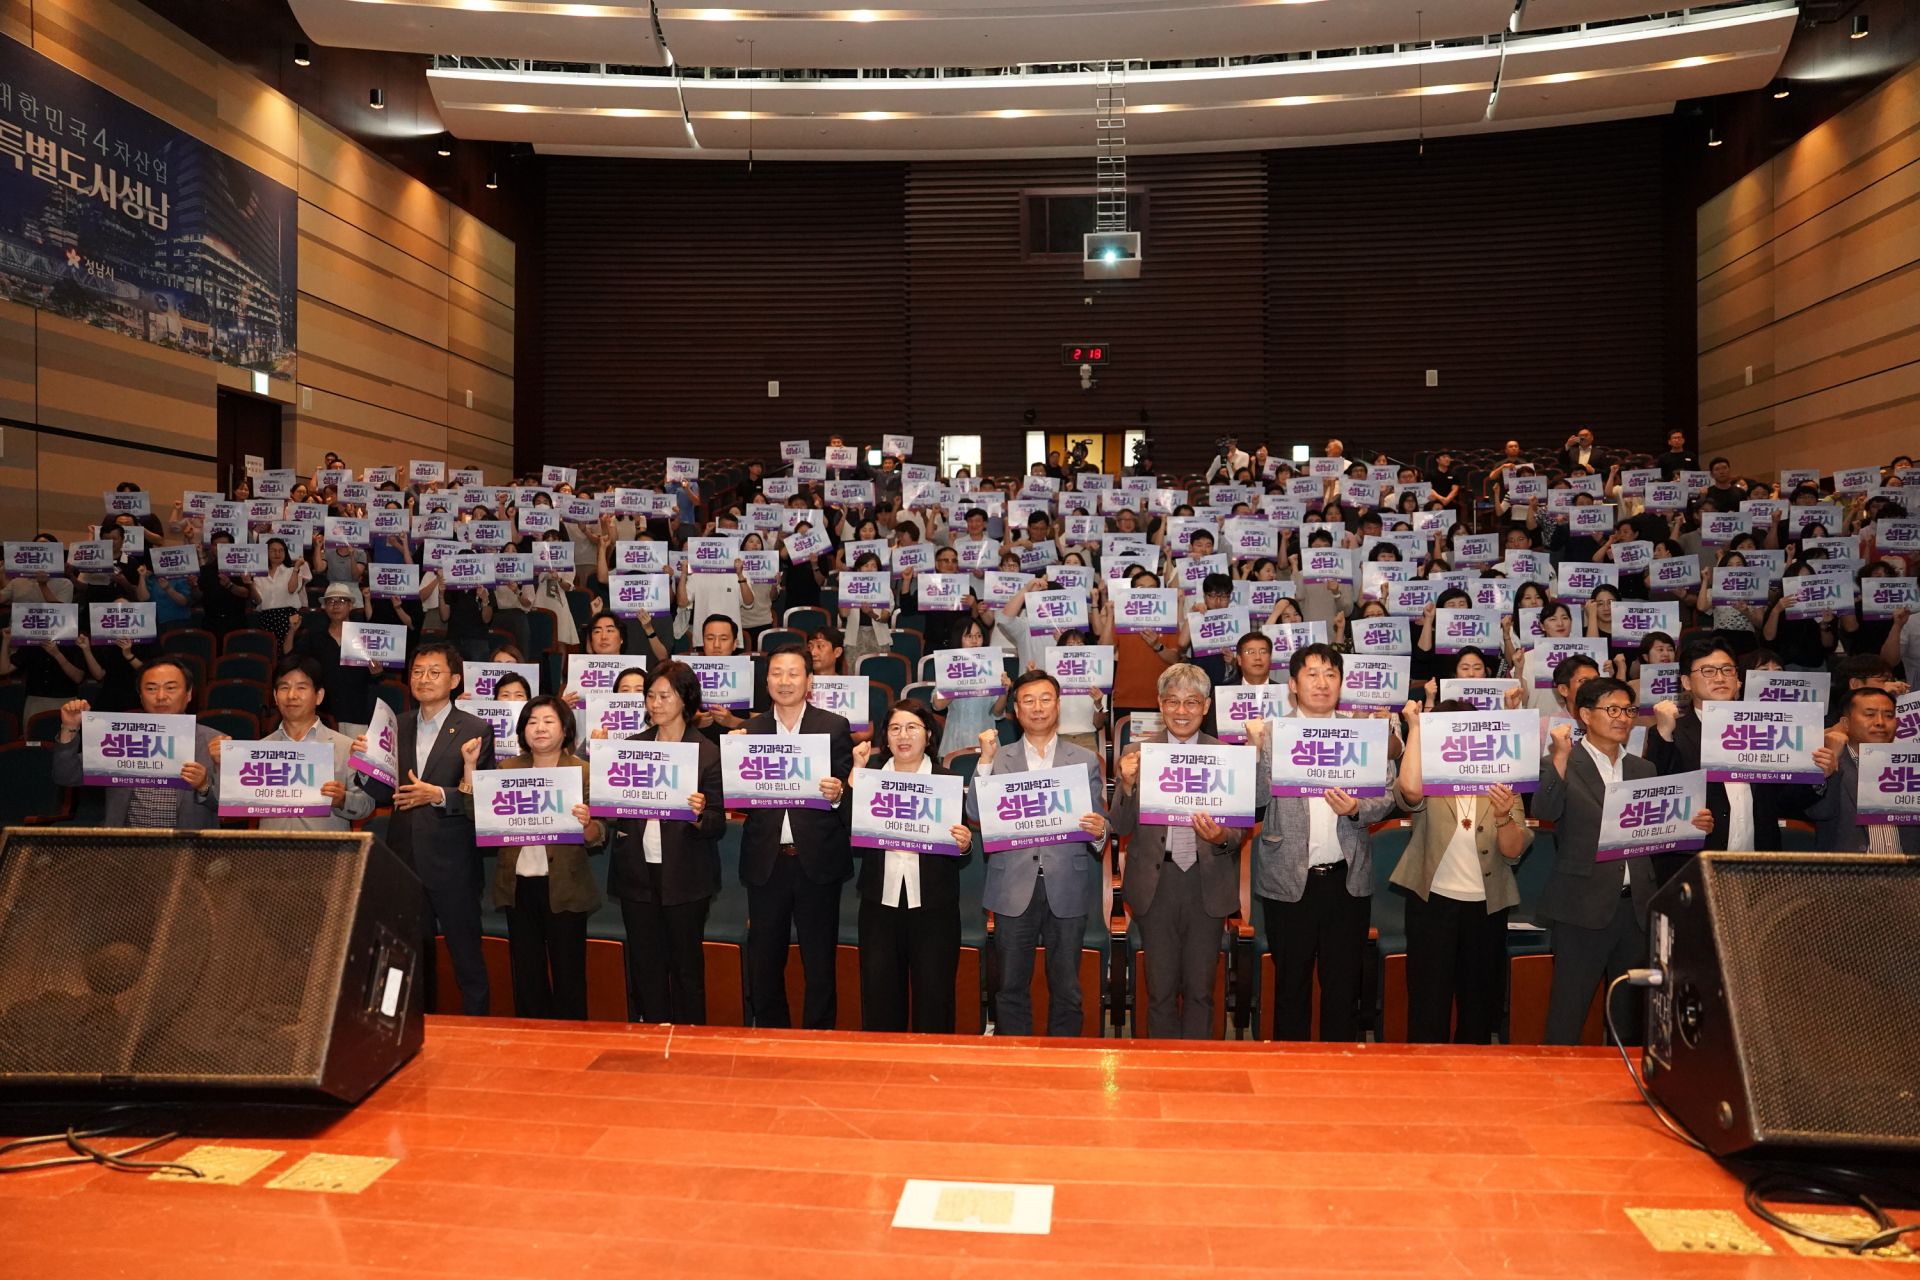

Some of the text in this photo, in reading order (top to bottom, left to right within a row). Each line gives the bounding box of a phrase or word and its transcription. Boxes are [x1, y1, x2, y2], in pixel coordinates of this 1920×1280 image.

[85, 259, 114, 282] 성남시
[580, 670, 615, 687] 성남
[700, 672, 736, 689] 남시
[1346, 670, 1399, 689] 성남시
[1734, 712, 1792, 722] 경기과학고는
[111, 722, 164, 732] 경기과학고는
[1451, 721, 1510, 732] 경기과학고는
[1303, 728, 1357, 738] 경기과학고는
[1720, 724, 1802, 750] 성남시
[100, 733, 174, 758] 성남시
[748, 744, 800, 753] 경기과학고는
[1440, 734, 1522, 762] 성남시
[250, 750, 304, 759] 경기과학고는
[618, 750, 668, 761] 경기과학고는
[1170, 754, 1224, 765] 경기과학고는
[1290, 740, 1368, 767] 성남시
[1760, 753, 1789, 762] 합니다
[137, 760, 162, 769] 합니다
[738, 756, 811, 780] 성남시
[1481, 763, 1509, 773] 합니다
[238, 761, 314, 786] 성남시
[607, 761, 678, 788] 성남시
[1327, 768, 1355, 778] 합니다
[501, 777, 552, 788] 경기과학고는
[774, 782, 800, 790] 합니다
[1005, 779, 1059, 792] 경기과학고는
[1158, 766, 1234, 794] 성남시
[275, 788, 302, 797] 합니다
[881, 780, 932, 793] 경기과학고는
[1633, 785, 1683, 799] 경기과학고는
[641, 790, 666, 799] 합니다
[492, 789, 564, 815] 성남시
[870, 791, 941, 822] 성남시
[996, 789, 1073, 820] 성남시
[1195, 796, 1222, 806] 합니다
[1619, 795, 1691, 828] 성남시
[527, 816, 553, 825] 합니다
[1035, 816, 1062, 828] 합니다
[904, 822, 929, 833] 합니다
[1651, 825, 1677, 837] 합니다
